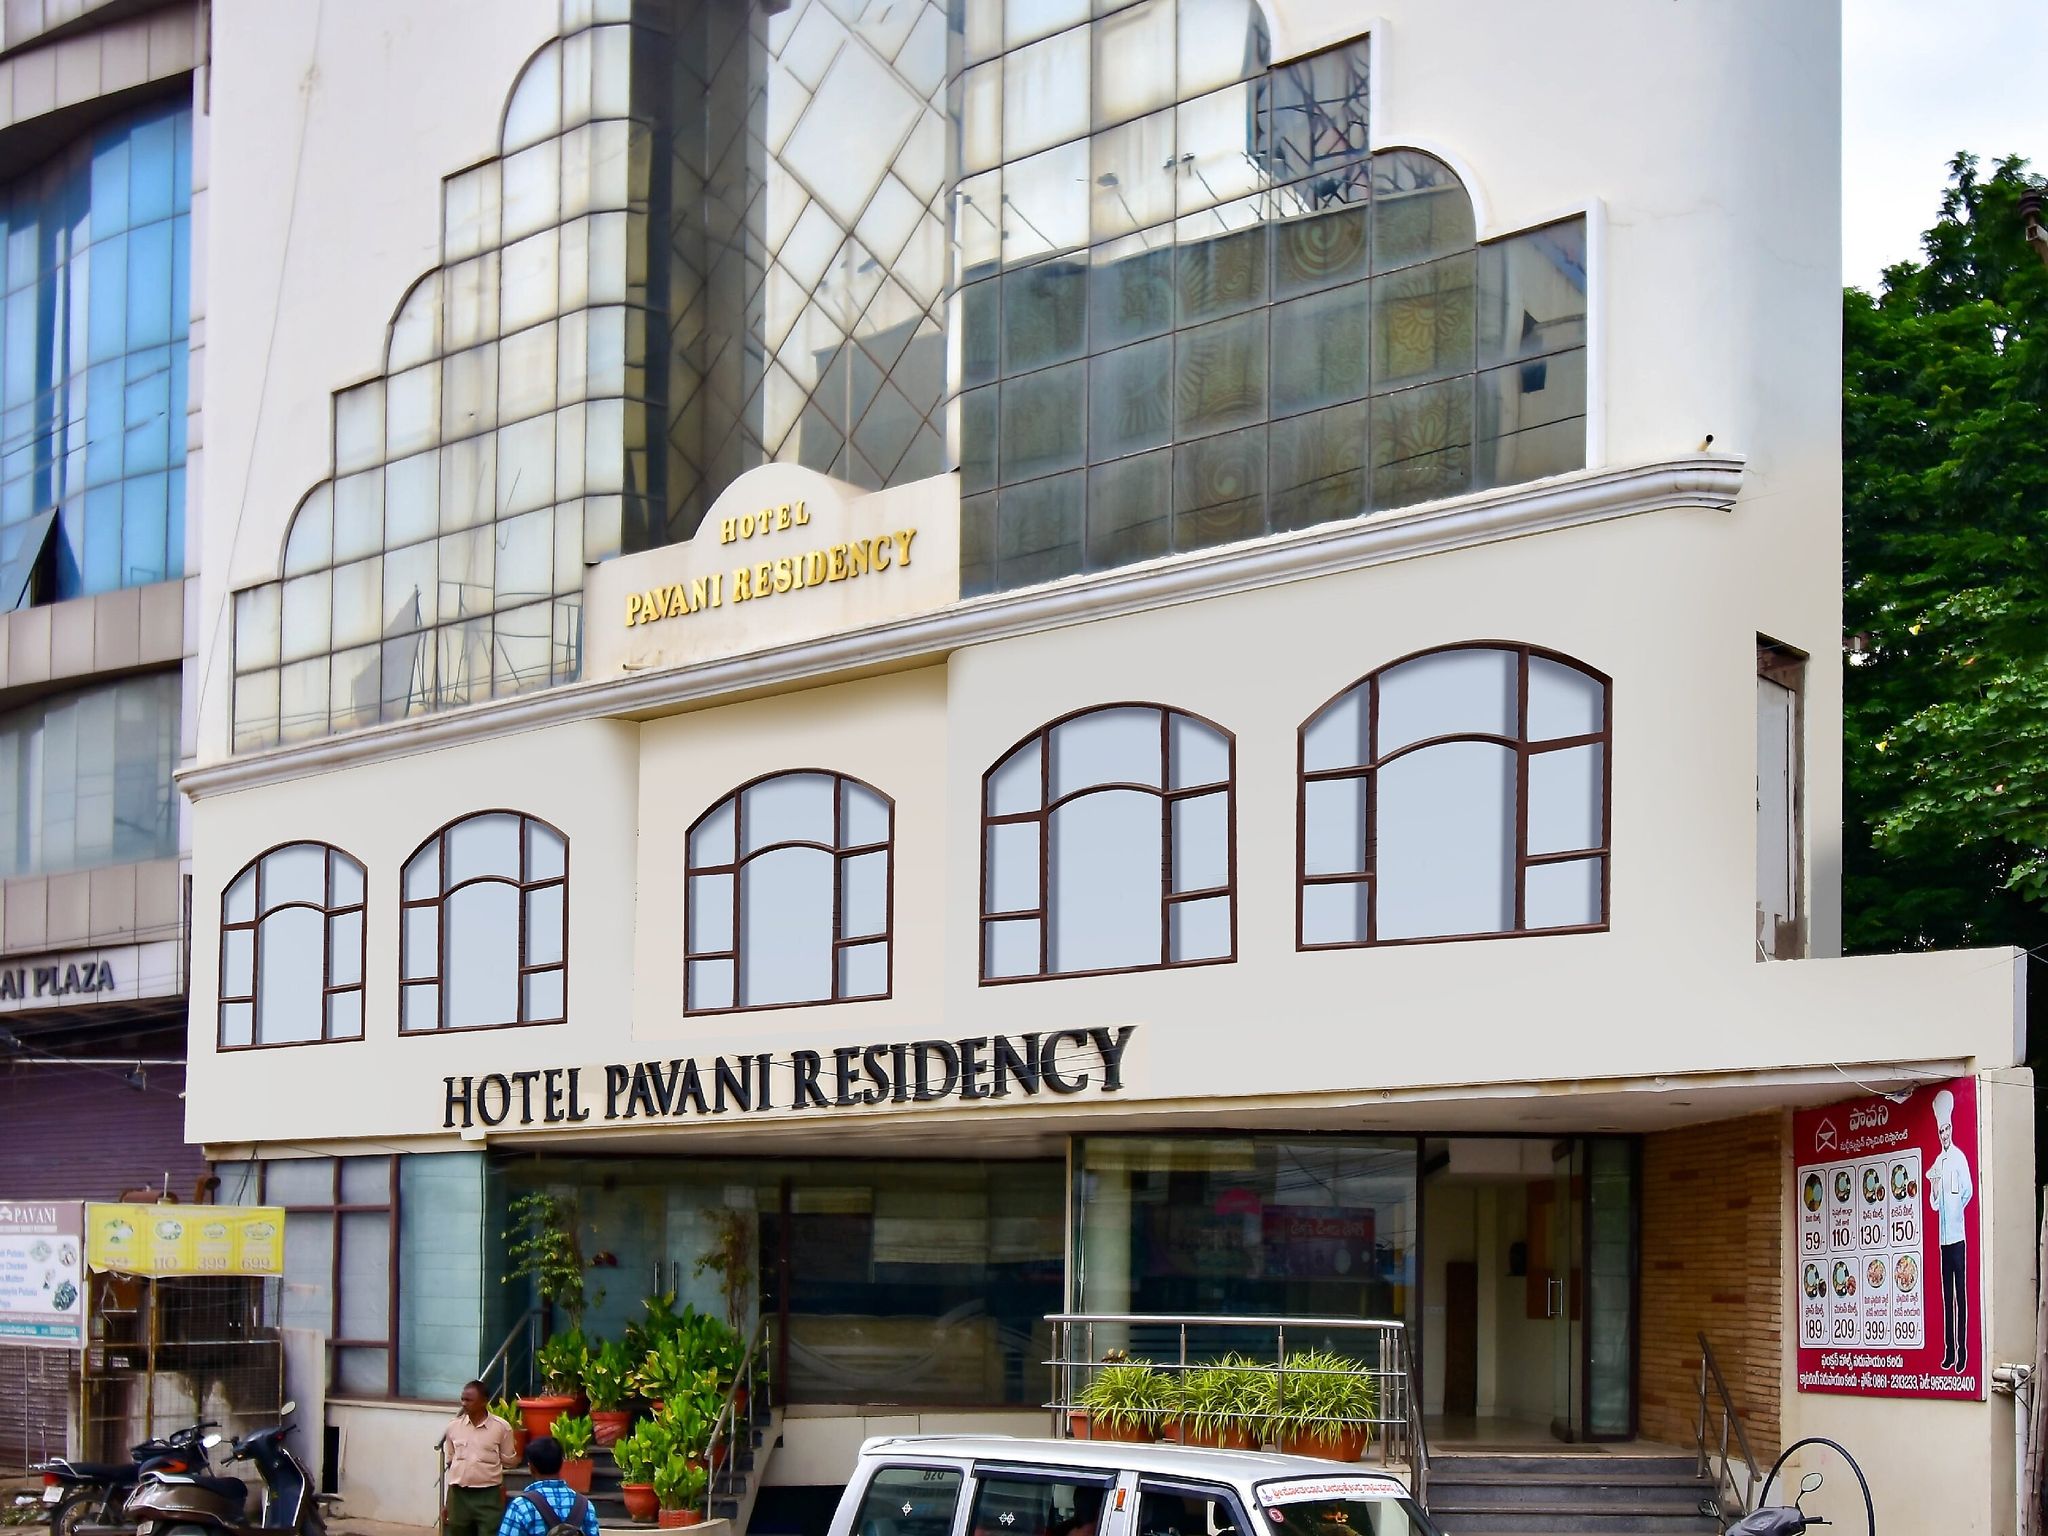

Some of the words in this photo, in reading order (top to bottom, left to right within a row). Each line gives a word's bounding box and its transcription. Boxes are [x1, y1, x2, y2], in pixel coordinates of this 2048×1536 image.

[720, 501, 811, 544] HOTEL
[625, 574, 723, 627] PAVANI
[732, 527, 918, 603] RESIDENCY
[33, 960, 115, 997] PLAZA
[442, 1067, 590, 1129] HOTEL
[604, 1052, 774, 1120] PAVANI
[791, 1024, 1138, 1110] RESIDENCY
[1849, 1104, 1889, 1131] పావని
[14, 1207, 56, 1224] PAVANI
[1930, 1376, 1976, 1392] 9652592400
